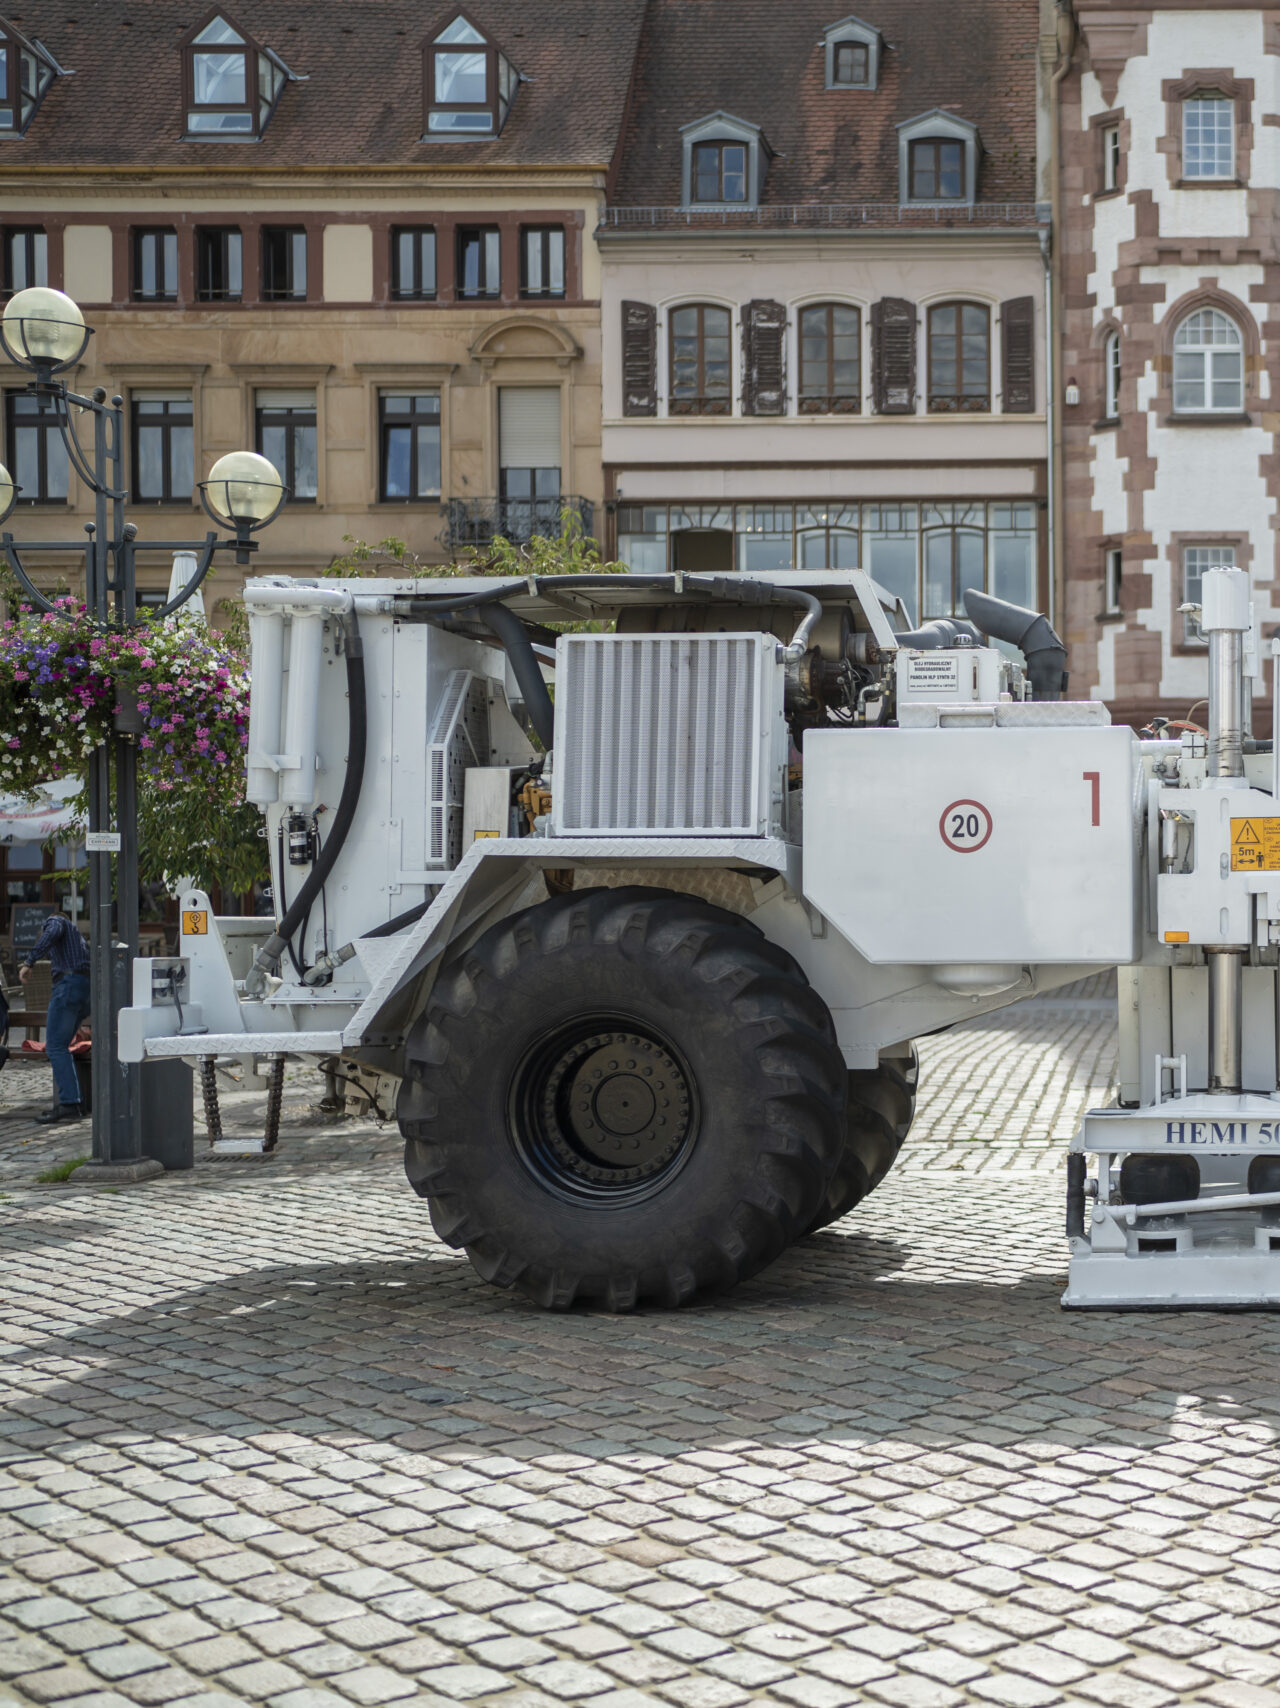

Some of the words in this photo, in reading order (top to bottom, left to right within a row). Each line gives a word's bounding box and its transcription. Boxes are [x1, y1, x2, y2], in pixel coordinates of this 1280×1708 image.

[1083, 771, 1100, 827] 1
[951, 814, 979, 838] 20
[1238, 847, 1255, 856] 5m
[1164, 1121, 1249, 1145] HEMI
